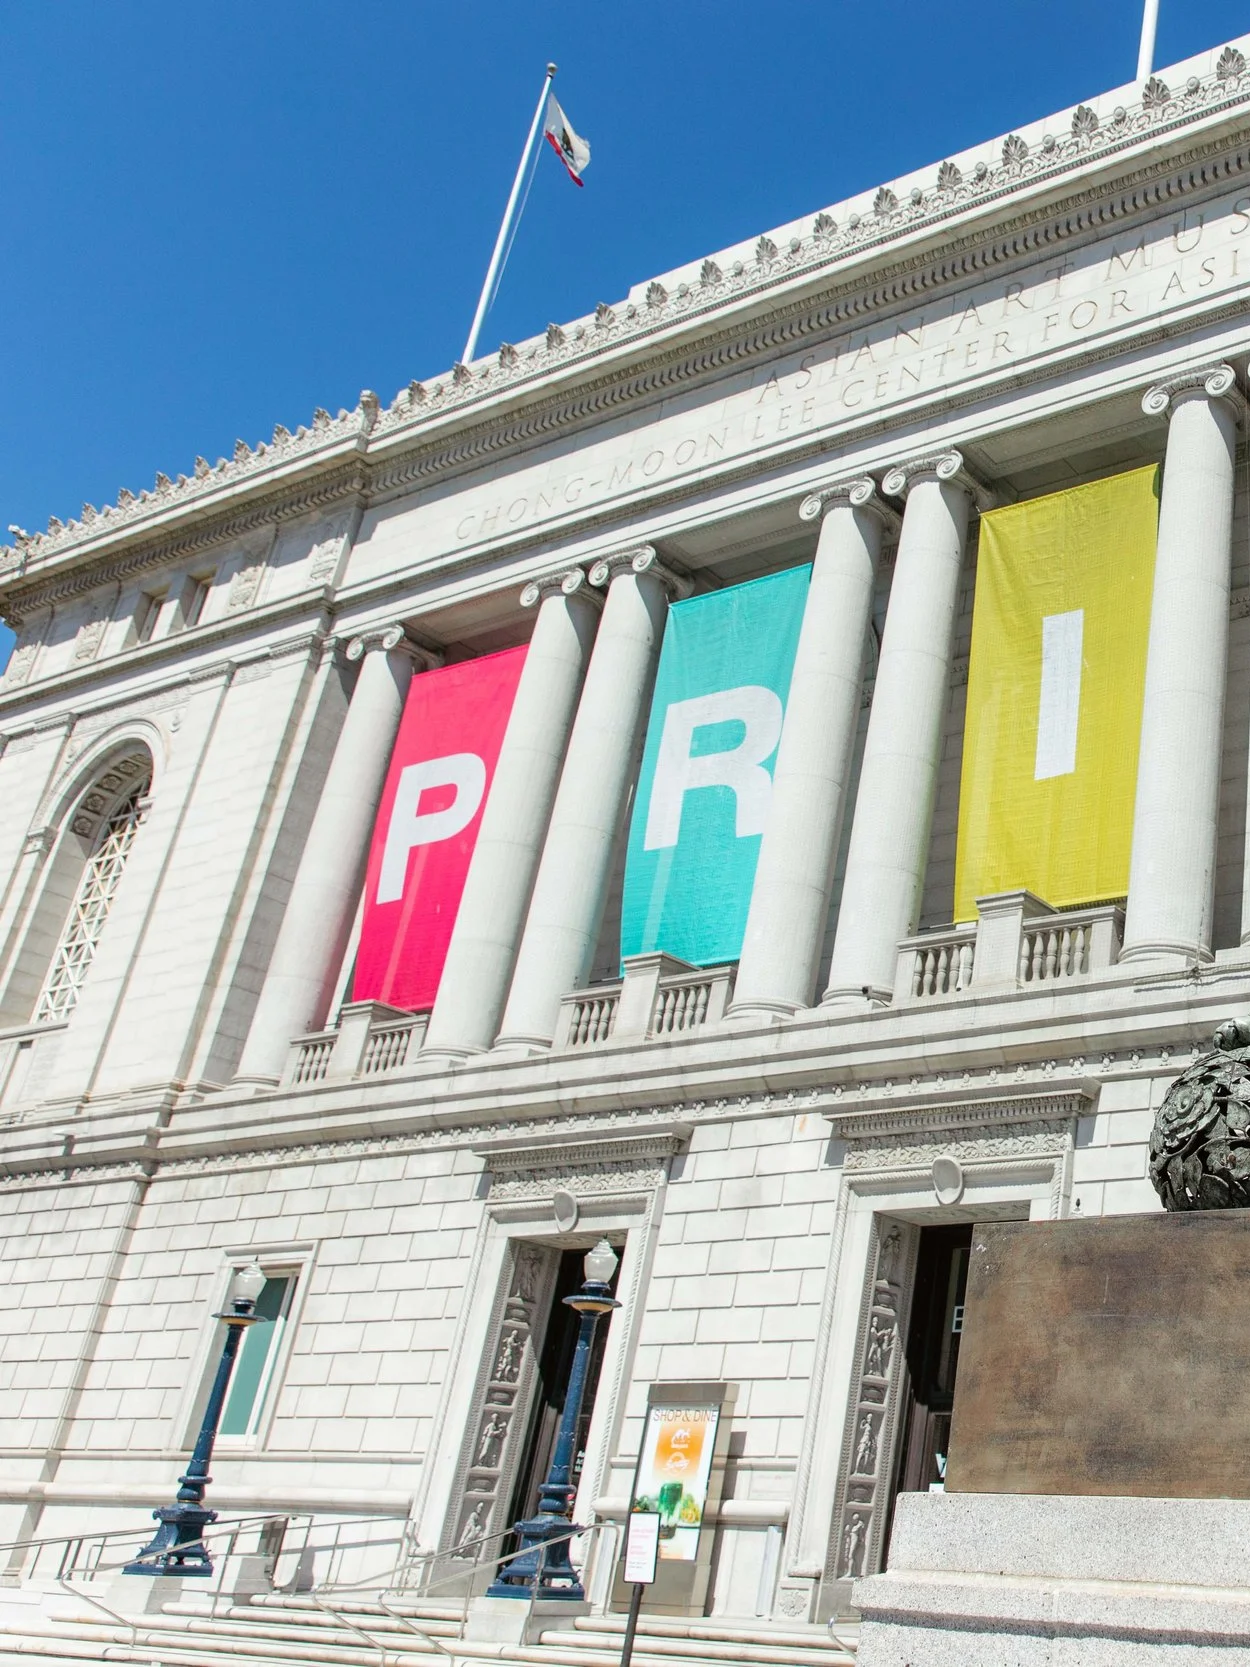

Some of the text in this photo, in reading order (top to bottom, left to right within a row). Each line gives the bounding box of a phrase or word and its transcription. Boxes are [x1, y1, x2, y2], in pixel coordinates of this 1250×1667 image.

[757, 317, 924, 404] ASIAN
[954, 262, 1074, 334] ART
[456, 427, 730, 540] CHONG-MOON
[752, 397, 816, 441] LEE
[841, 331, 1014, 408] CENTER
[1042, 289, 1134, 342] FOR
[643, 685, 783, 852] R
[1034, 608, 1084, 781] I
[376, 752, 487, 904] P
[653, 1409, 719, 1422] SHOP & DINE
